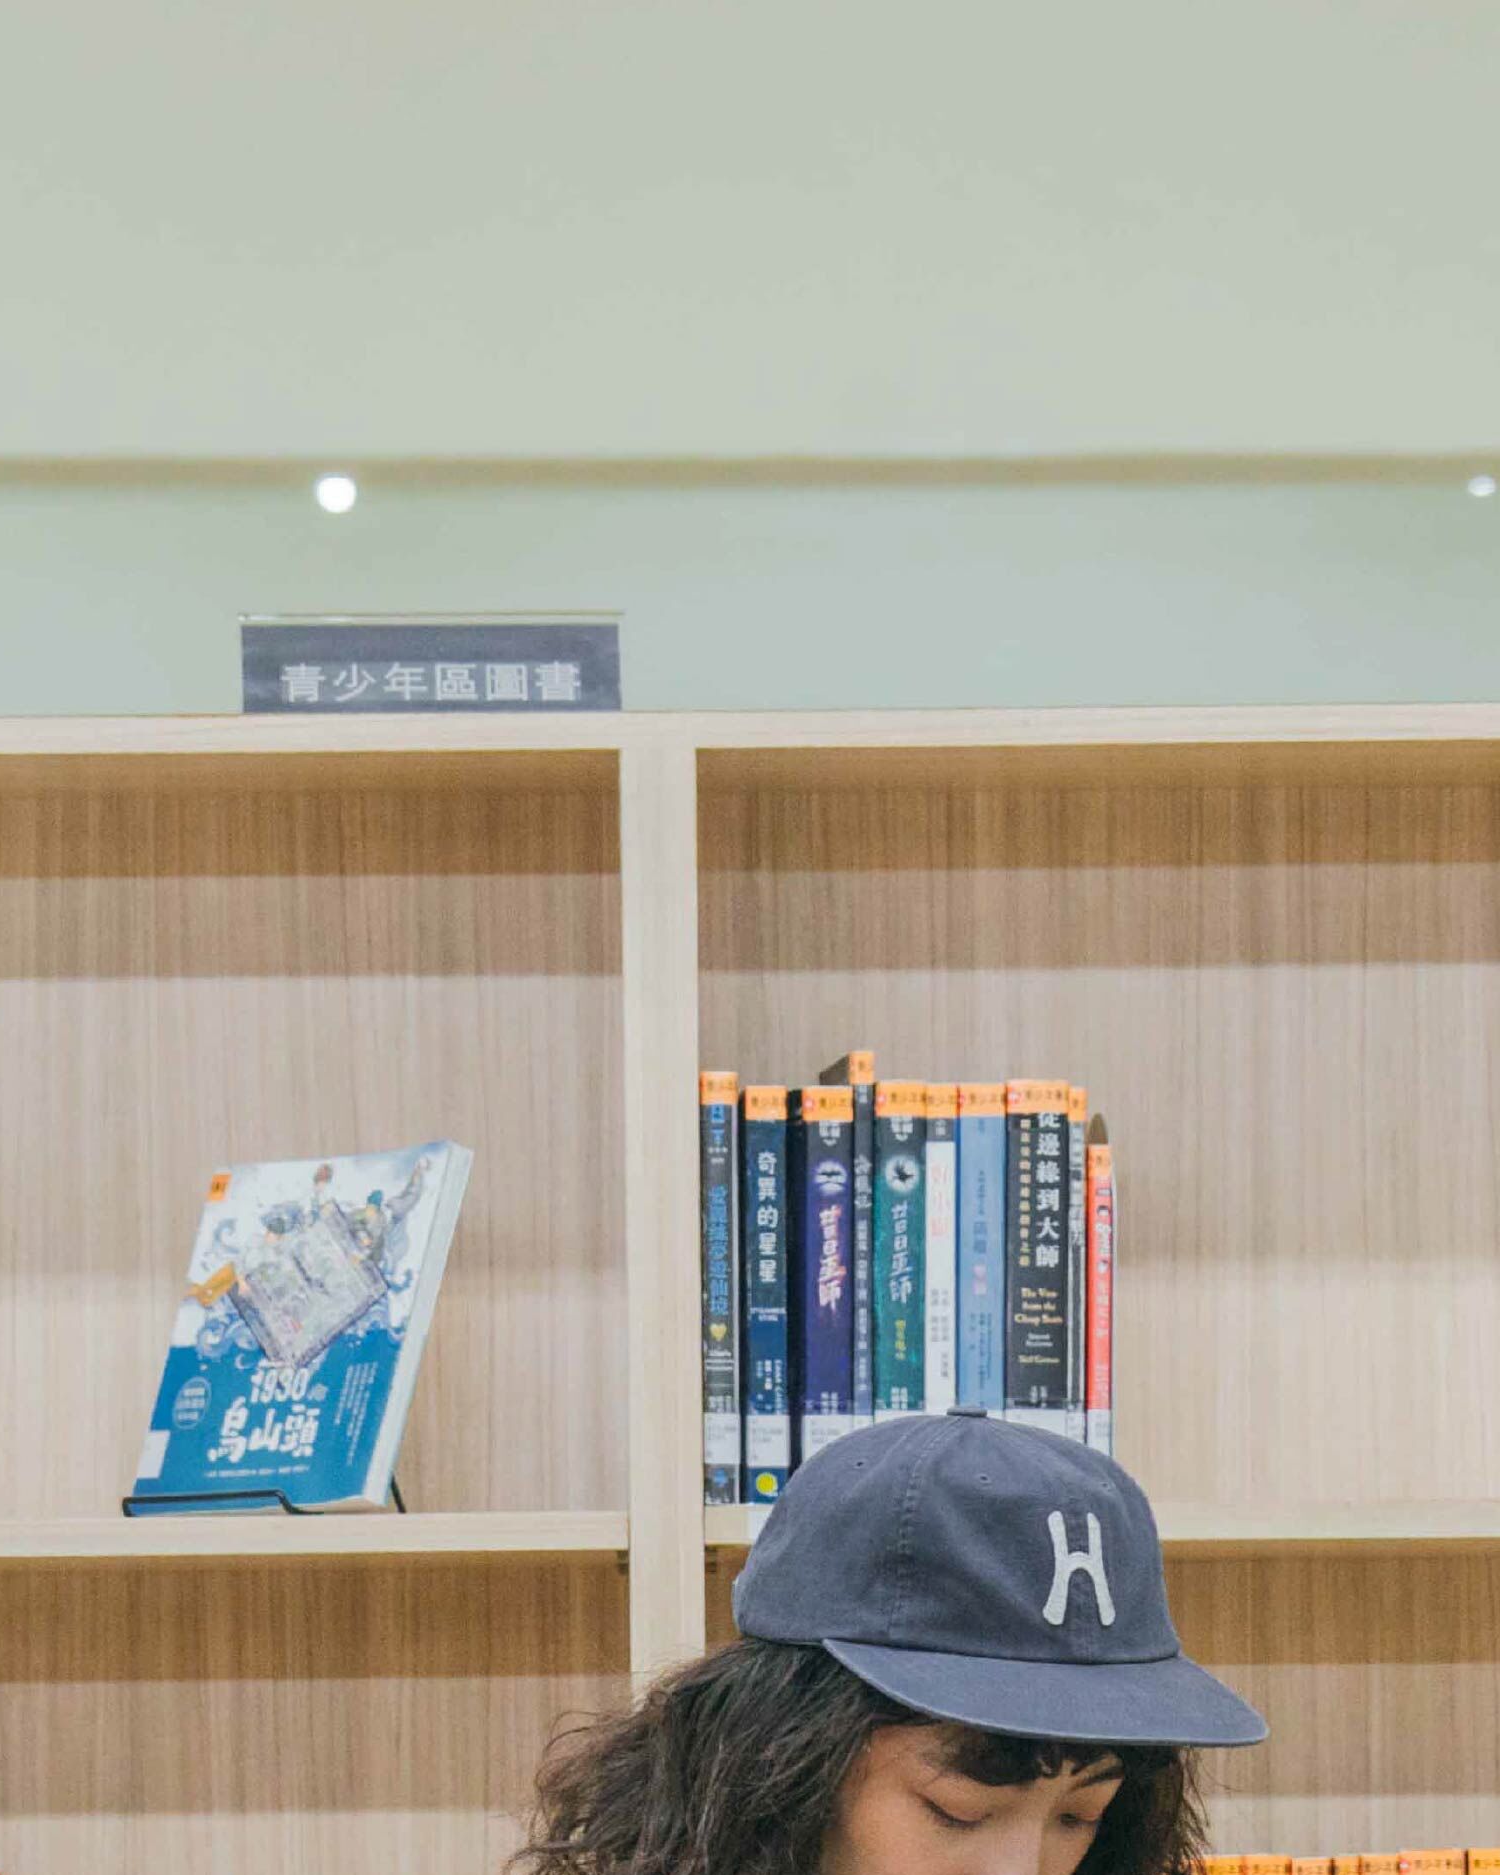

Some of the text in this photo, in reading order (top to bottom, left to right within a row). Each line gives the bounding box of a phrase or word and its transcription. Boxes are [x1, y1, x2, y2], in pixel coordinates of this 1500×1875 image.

[280, 661, 582, 703] 青少年區圖書
[756, 1151, 779, 1284] 奇異的星星
[1042, 1510, 1116, 1626] H
